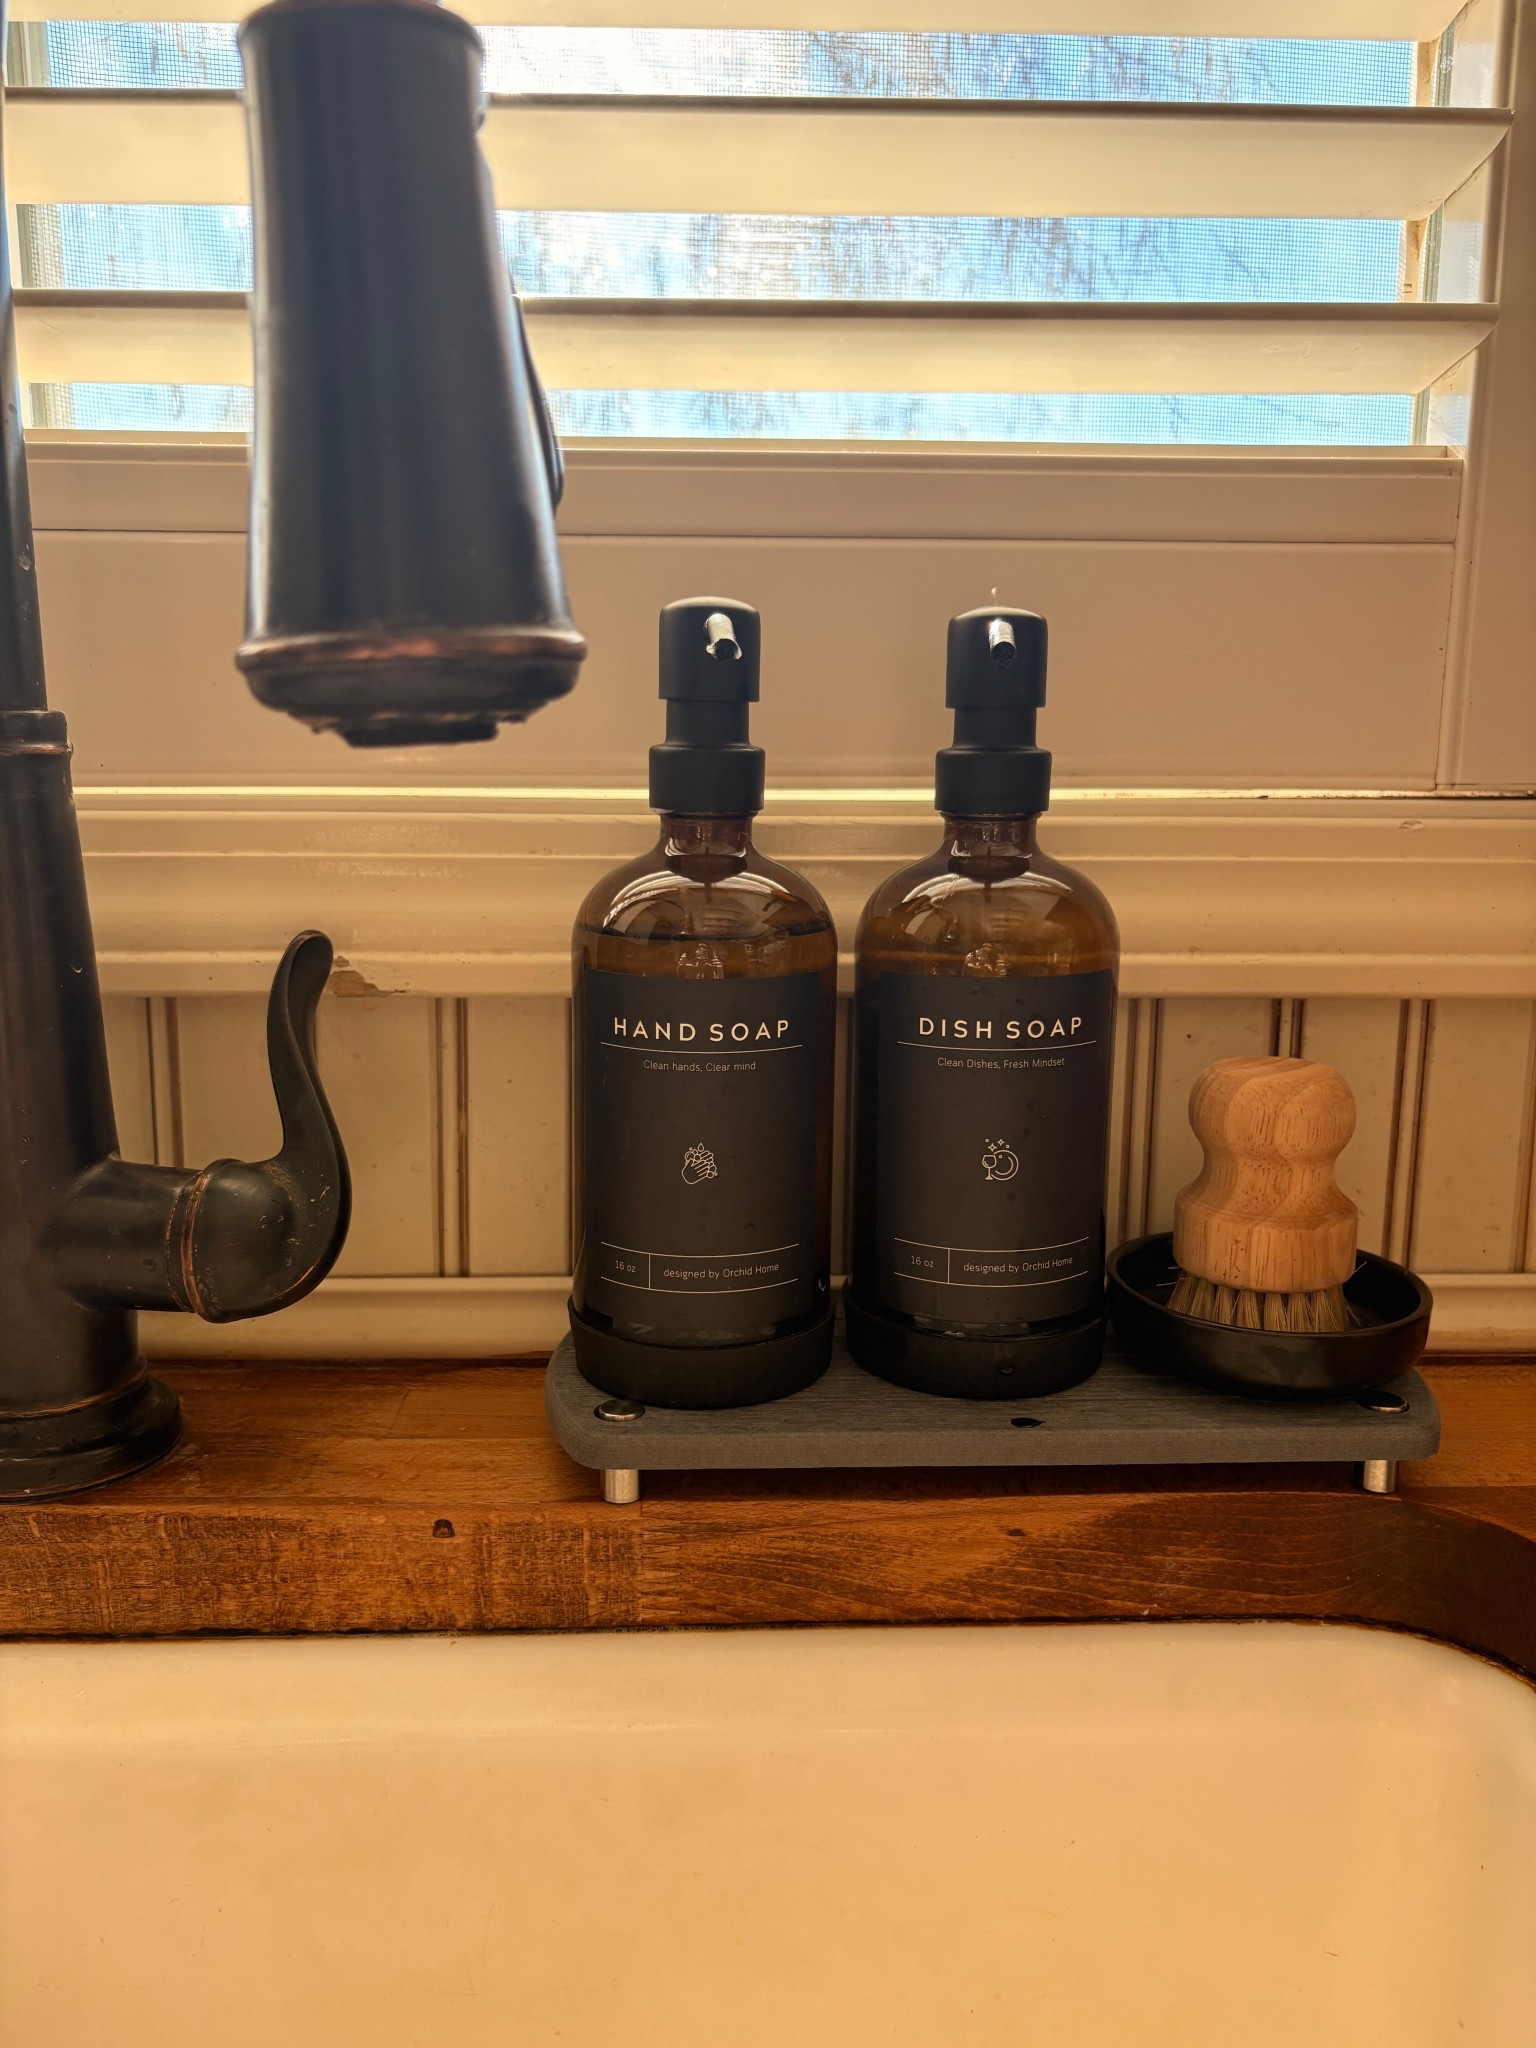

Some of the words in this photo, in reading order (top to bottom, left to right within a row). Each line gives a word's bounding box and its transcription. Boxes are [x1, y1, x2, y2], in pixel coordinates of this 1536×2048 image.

[613, 1016, 697, 1042] HAND
[709, 1019, 790, 1042] SOAP
[919, 1016, 992, 1039] DISH
[1006, 1016, 1082, 1039] SOAP
[643, 1059, 669, 1071] Clean
[672, 1061, 704, 1072] hands,
[705, 1062, 731, 1072] Clear
[733, 1061, 756, 1071] mind
[937, 1057, 964, 1068] Clean
[966, 1059, 1001, 1070] Dishes,
[1003, 1059, 1029, 1069] Fresh
[1032, 1057, 1065, 1067] Mindset
[615, 1260, 625, 1271] 16
[626, 1265, 636, 1273] oz
[911, 1255, 921, 1266] 16
[923, 1260, 934, 1268] oz
[963, 1262, 1006, 1274] designed
[1008, 1263, 1020, 1273] by
[1022, 1259, 1050, 1271] Orchid
[1052, 1256, 1073, 1267] Home
[663, 1268, 706, 1280] designed
[708, 1269, 720, 1279] by
[723, 1266, 753, 1278] Orchid
[755, 1263, 779, 1275] Home
